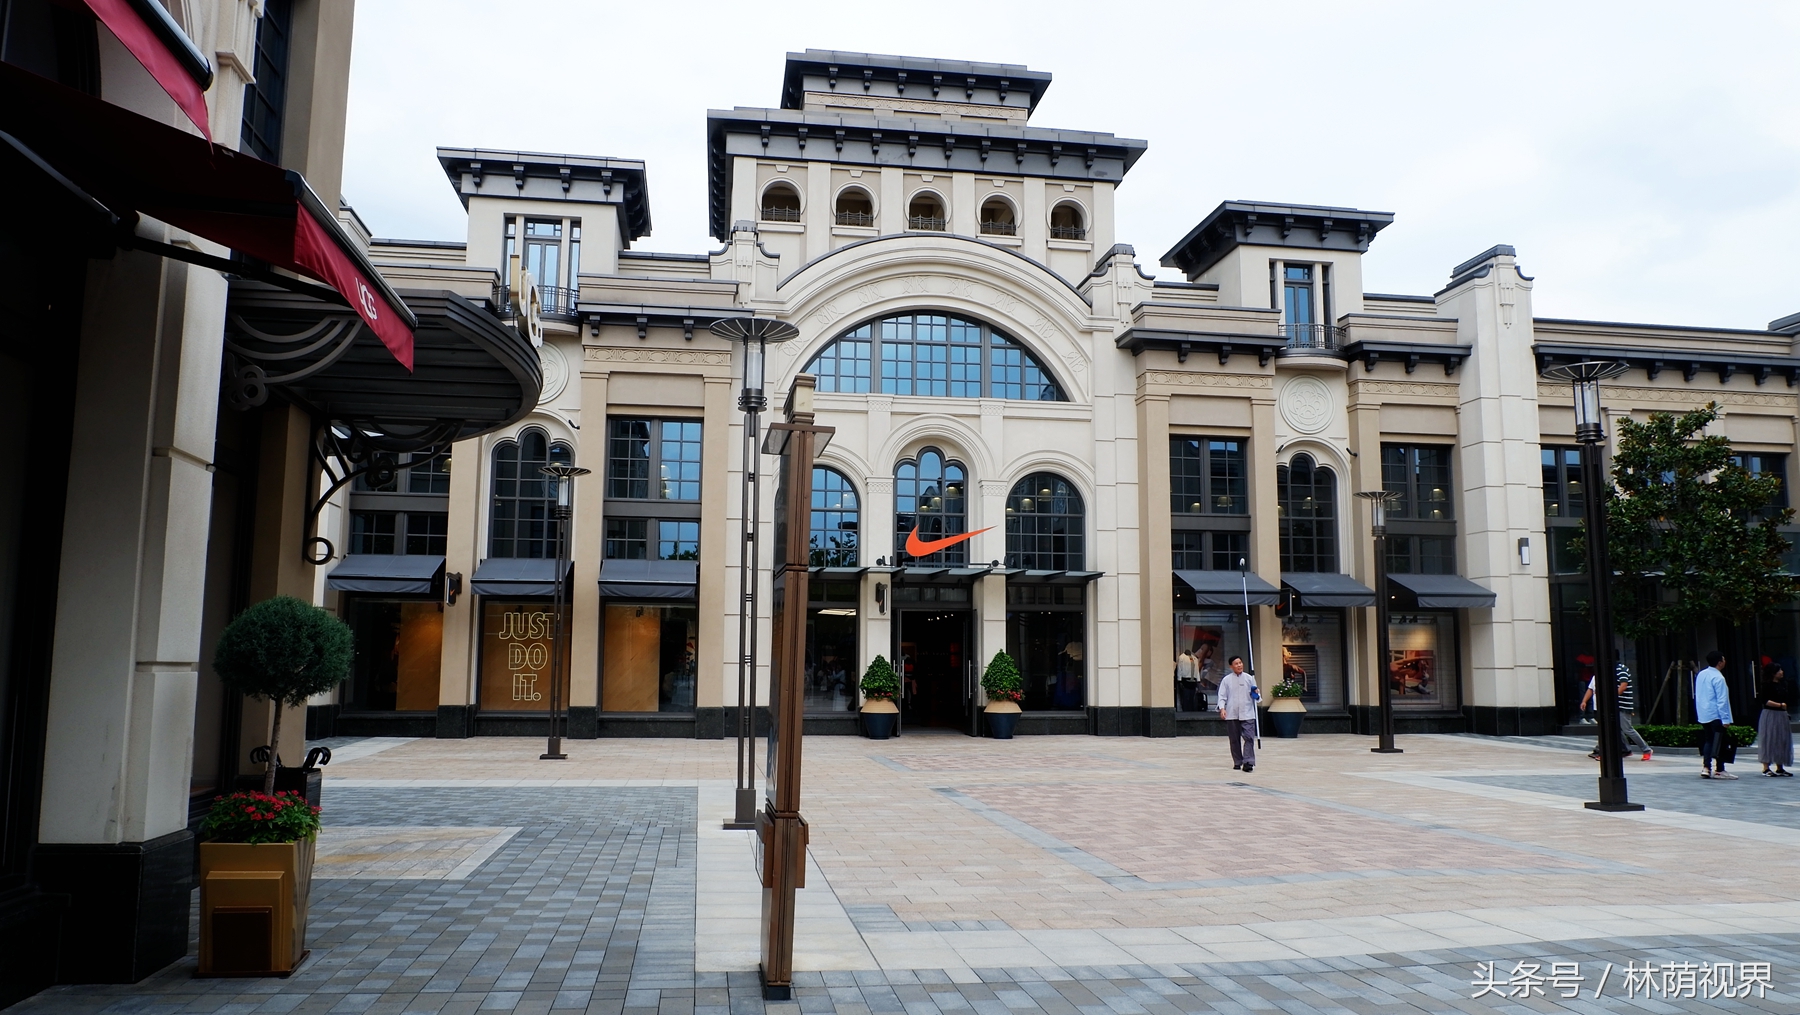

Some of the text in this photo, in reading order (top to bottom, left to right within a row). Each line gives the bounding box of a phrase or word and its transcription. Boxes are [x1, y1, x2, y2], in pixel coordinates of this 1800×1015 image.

[499, 611, 560, 640] JUST
[508, 642, 548, 670] DO
[512, 673, 542, 701] IT.
